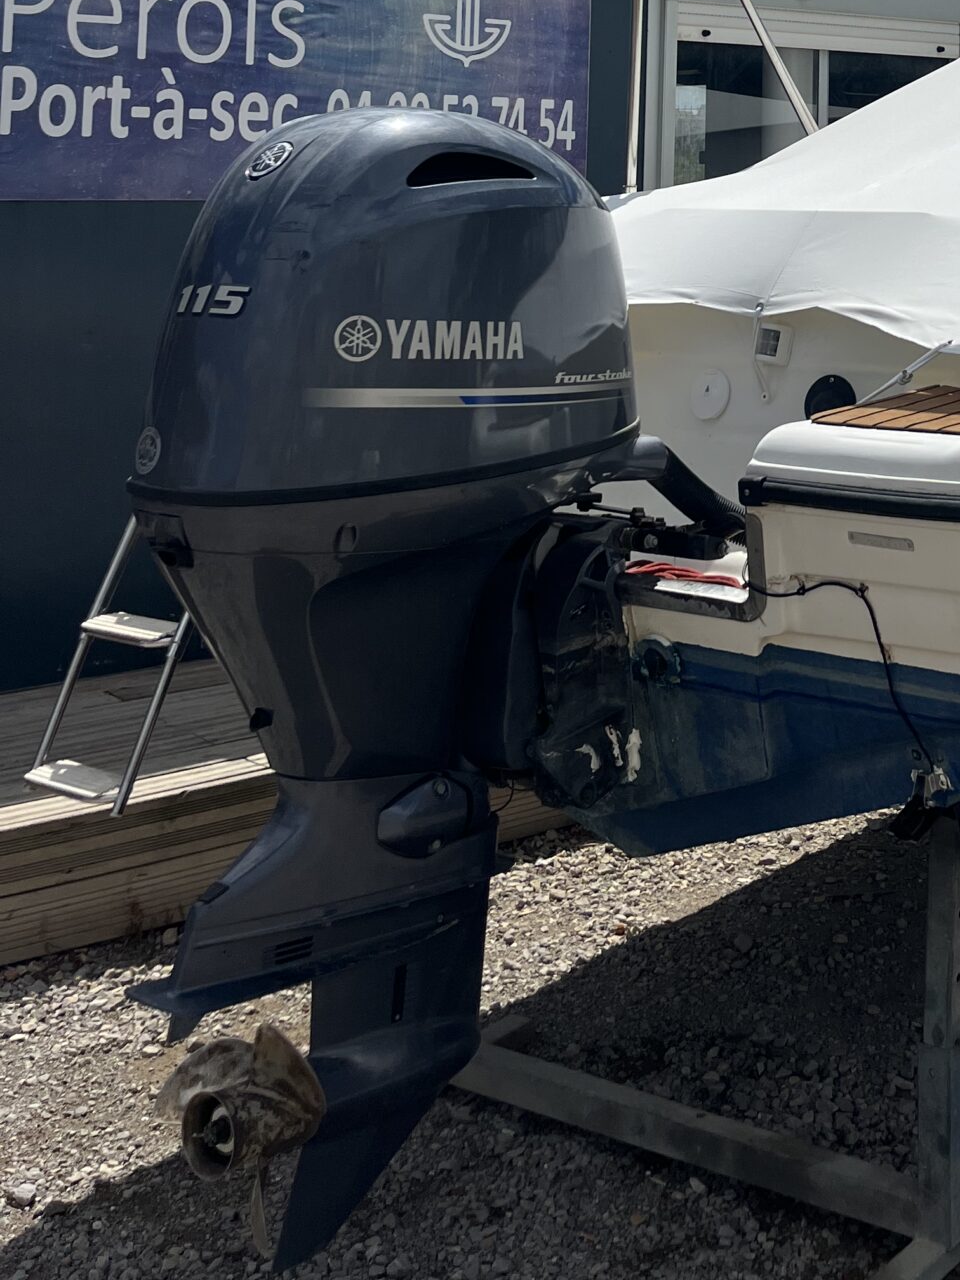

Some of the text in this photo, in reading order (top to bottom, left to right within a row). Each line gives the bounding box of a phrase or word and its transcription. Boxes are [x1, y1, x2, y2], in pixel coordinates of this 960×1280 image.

[0, 65, 299, 142] Port-à-sec
[538, 99, 576, 151] 54
[177, 284, 251, 315] 115
[386, 319, 524, 360] YAMAHA
